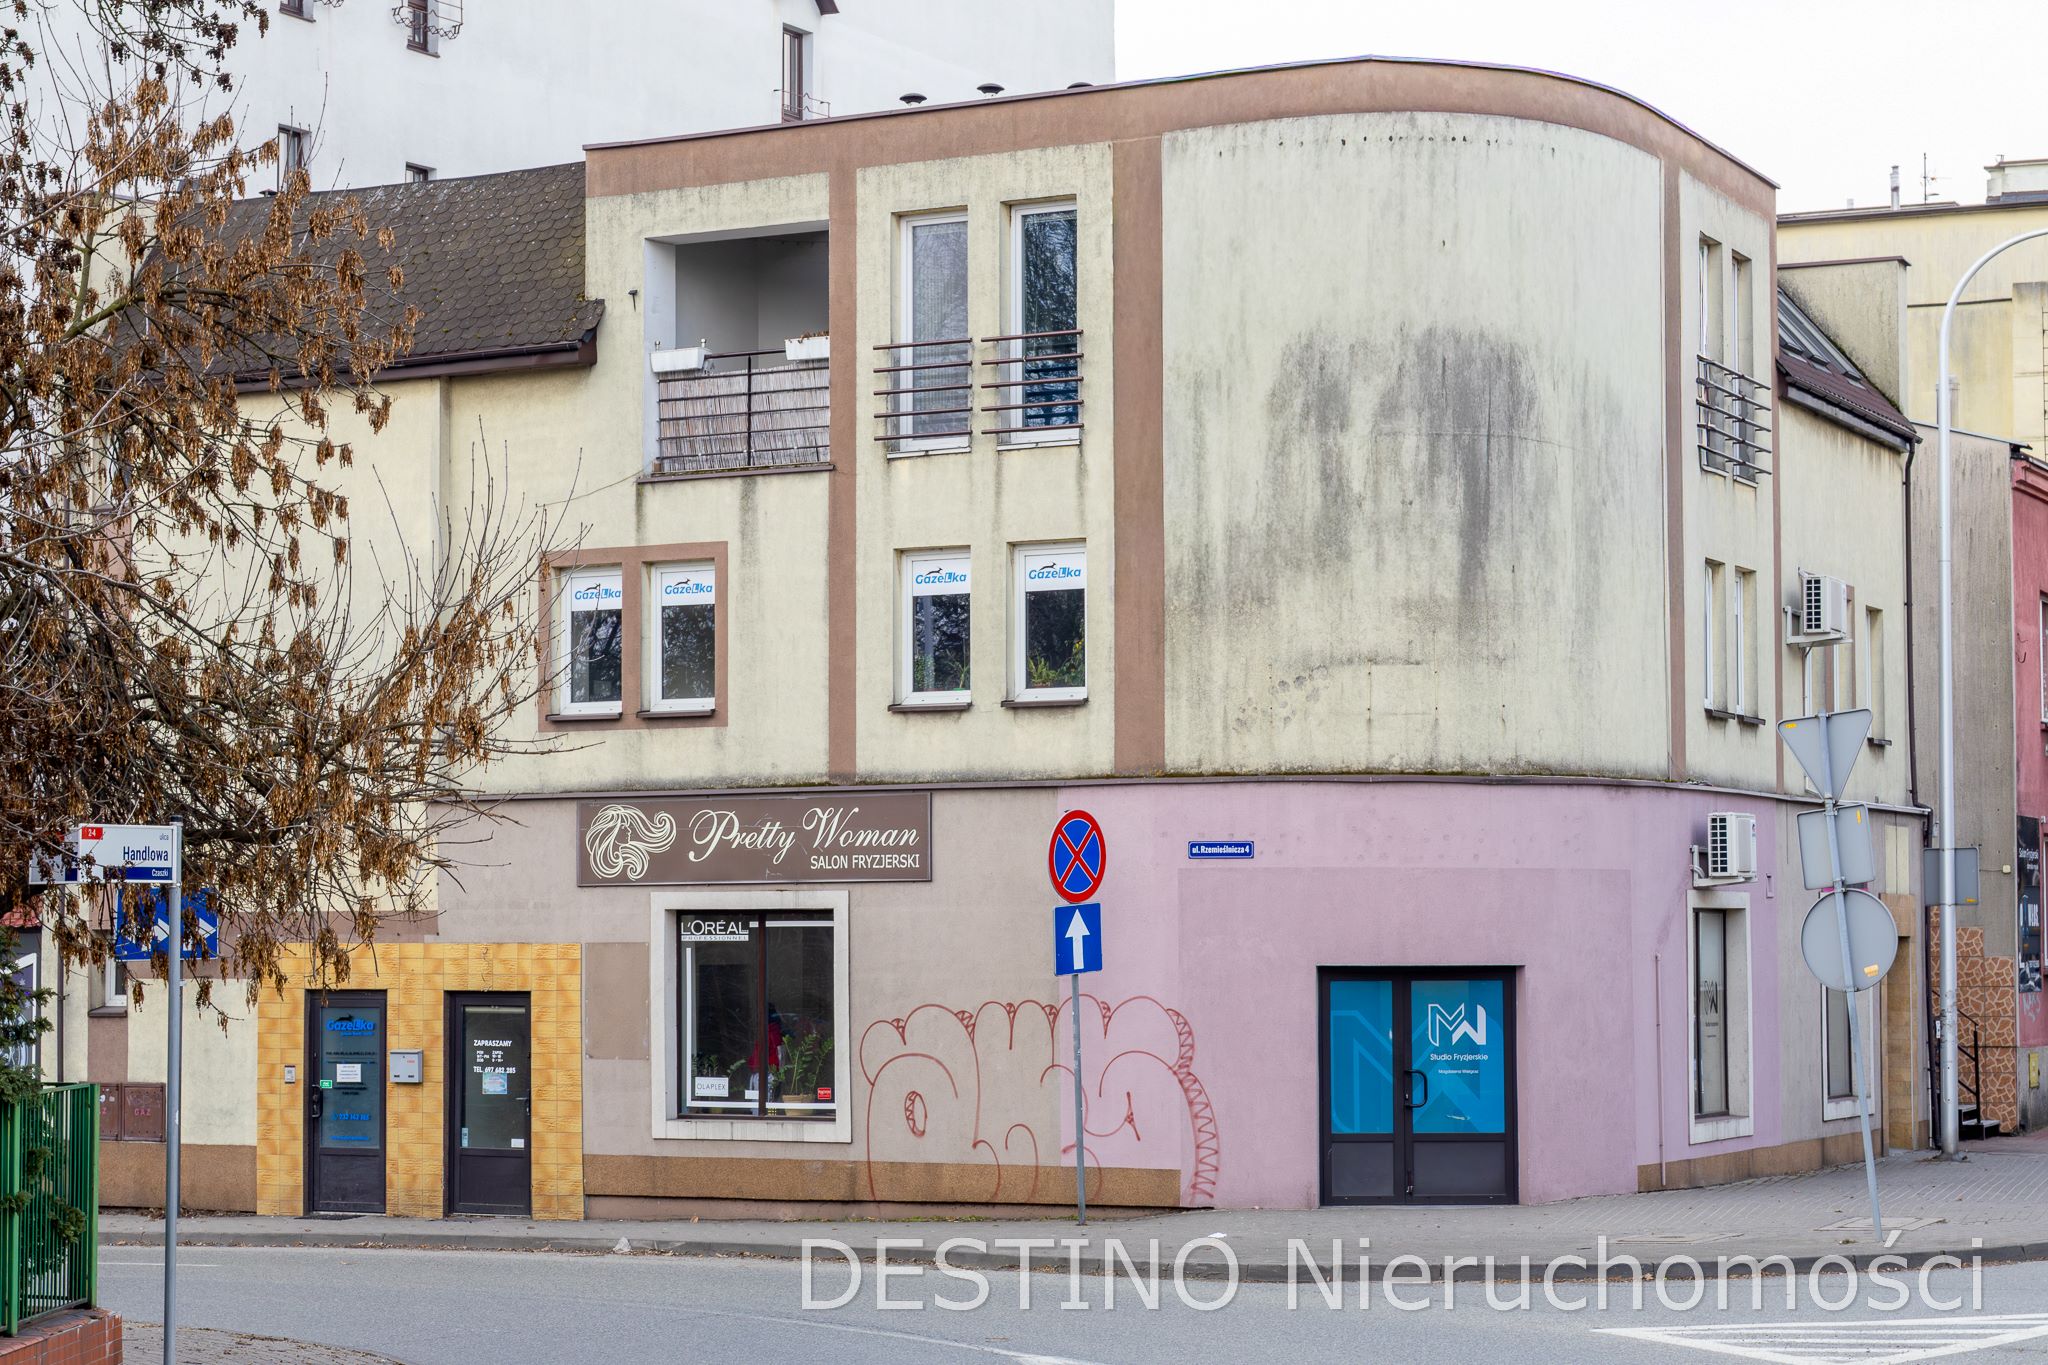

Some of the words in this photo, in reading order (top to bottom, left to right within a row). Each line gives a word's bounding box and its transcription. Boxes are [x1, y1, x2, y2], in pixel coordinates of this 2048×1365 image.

[688, 809, 796, 865] Pretty
[802, 807, 920, 849] Woman
[123, 846, 169, 862] Handlowa
[810, 854, 848, 869] SALON
[852, 853, 920, 869] FRYZJERSKI
[151, 868, 169, 877] Czaszki
[681, 919, 749, 935] L'ORÉAL
[473, 1039, 512, 1047] ZAPRASZAMY
[1430, 1053, 1452, 1061] Studio
[1453, 1053, 1488, 1062] Fryzjerskie
[696, 1083, 726, 1091] OLAPLEX
[134, 1108, 151, 1116] GAZ
